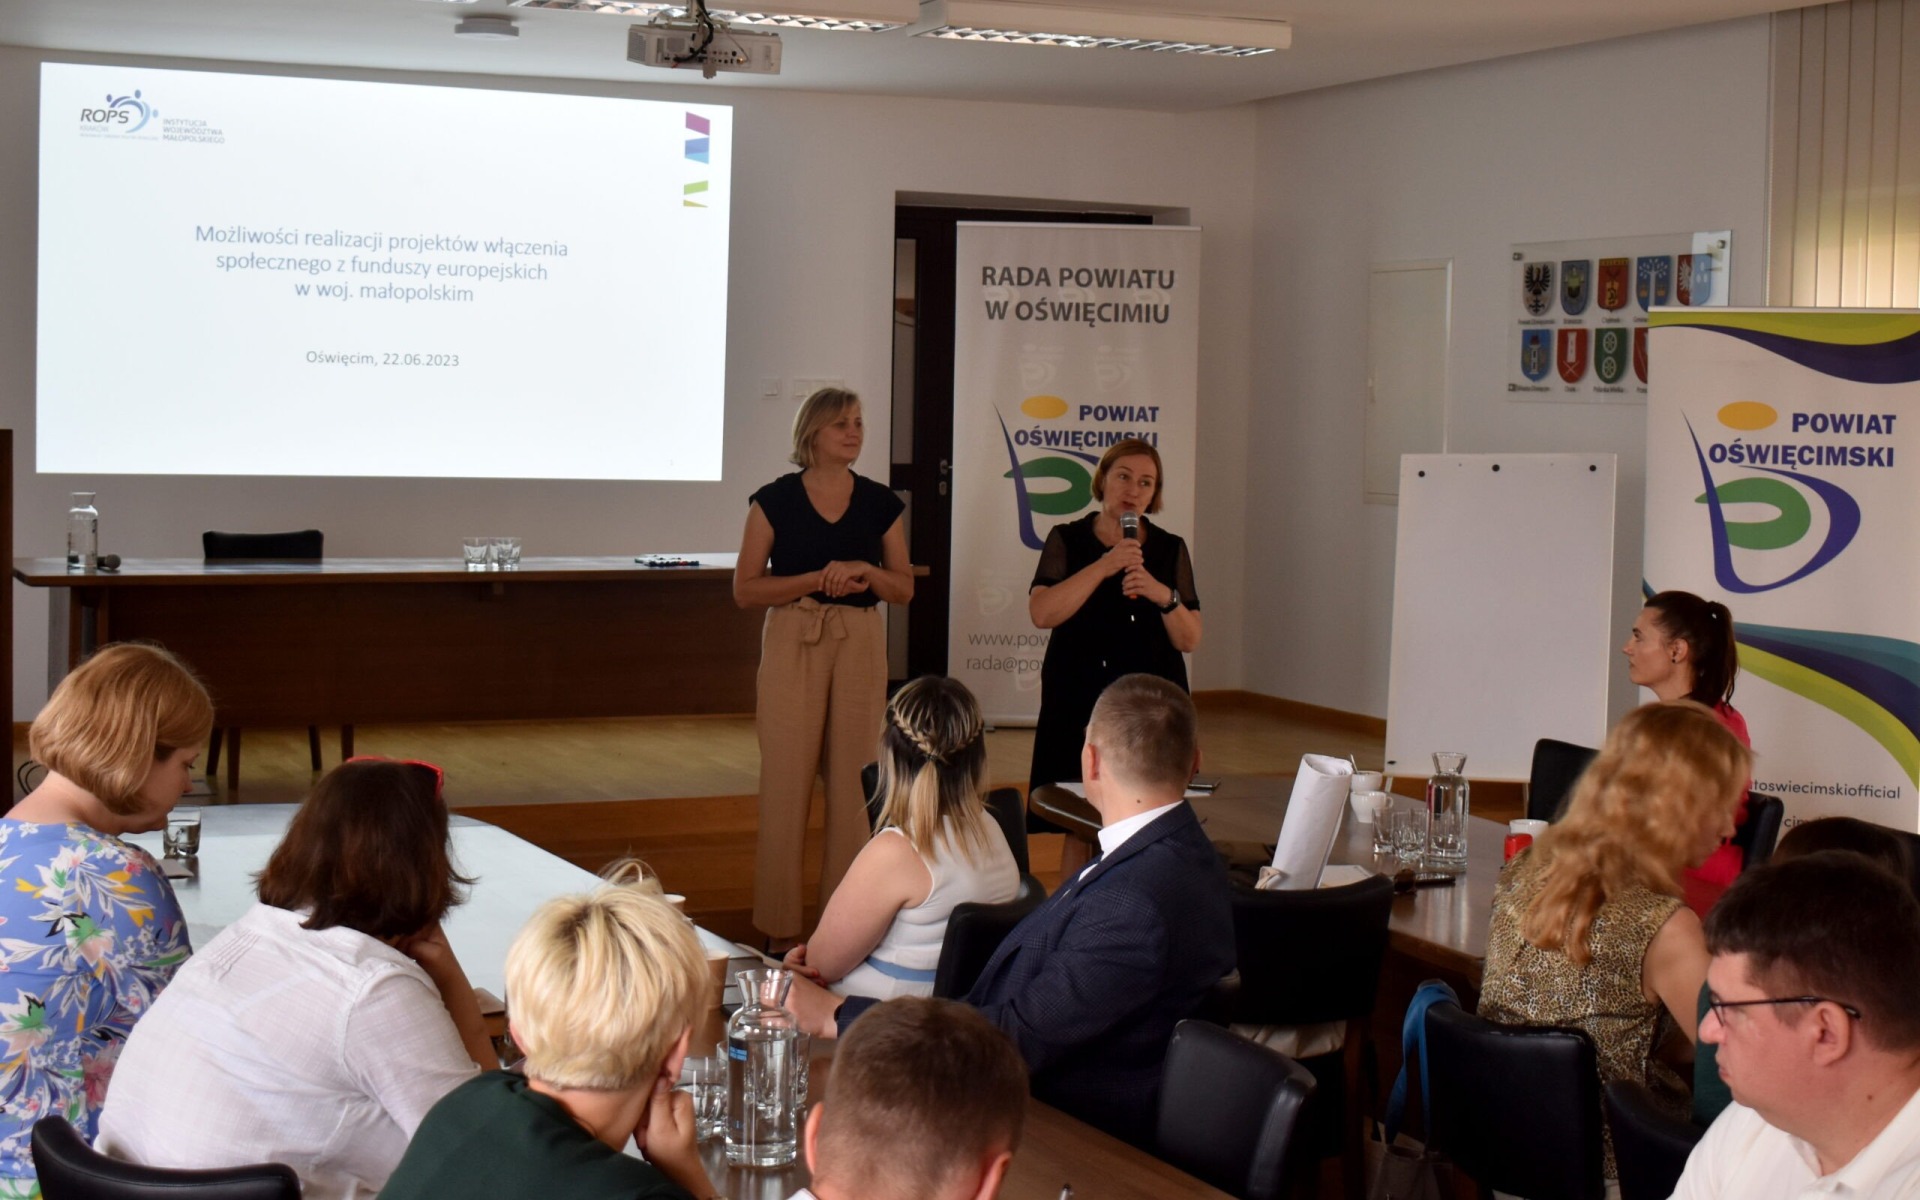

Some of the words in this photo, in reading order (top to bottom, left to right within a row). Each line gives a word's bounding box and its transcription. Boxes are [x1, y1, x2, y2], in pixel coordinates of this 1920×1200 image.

[80, 108, 130, 124] ROPS
[163, 118, 207, 127] INSTYTUCJA
[163, 125, 223, 136] WOJEWÓDZTWA
[163, 134, 225, 144] MAŁOPOLSKIEGO
[195, 225, 298, 245] Możliwości
[305, 229, 382, 252] realizacji
[389, 233, 478, 253] projektów
[484, 236, 568, 257] włączenia
[216, 252, 331, 275] społecznego
[337, 260, 345, 272] z
[351, 255, 431, 278] funduszy
[437, 260, 547, 281] europejskich
[982, 266, 1051, 287] RADA
[1059, 267, 1175, 289] POWIATU
[295, 283, 311, 296] w
[316, 282, 353, 300] woj.
[360, 281, 473, 303] małopolskim
[985, 300, 1009, 320] W
[1015, 297, 1170, 328] OŚWIĘCIMIU
[306, 349, 378, 366] Oświęcim,
[382, 352, 459, 367] 22.06.2023
[1079, 404, 1160, 423] POWIAT
[1792, 413, 1897, 434] POWIAT
[1709, 437, 1894, 470] OŚWIĘCIMSKI
